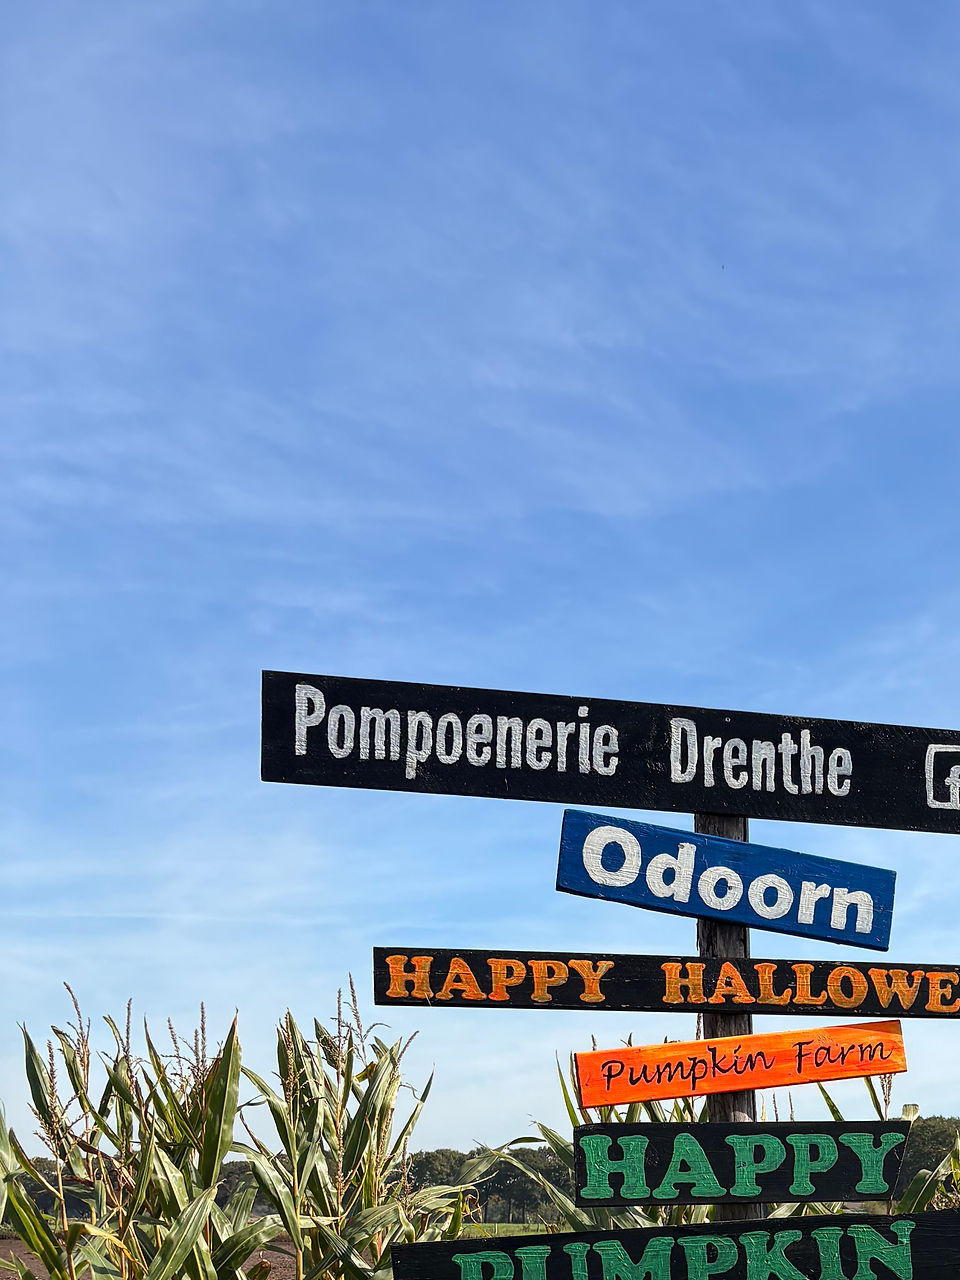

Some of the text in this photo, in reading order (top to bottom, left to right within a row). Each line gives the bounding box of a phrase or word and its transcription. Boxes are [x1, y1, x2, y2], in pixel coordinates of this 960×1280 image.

[294, 684, 853, 797] Pompoenerie Drenthe
[582, 825, 874, 934] Odoorn
[385, 954, 614, 1003] HAPPY
[601, 1038, 893, 1091] Pumpkin Farm
[579, 1132, 905, 1199] HAPPY
